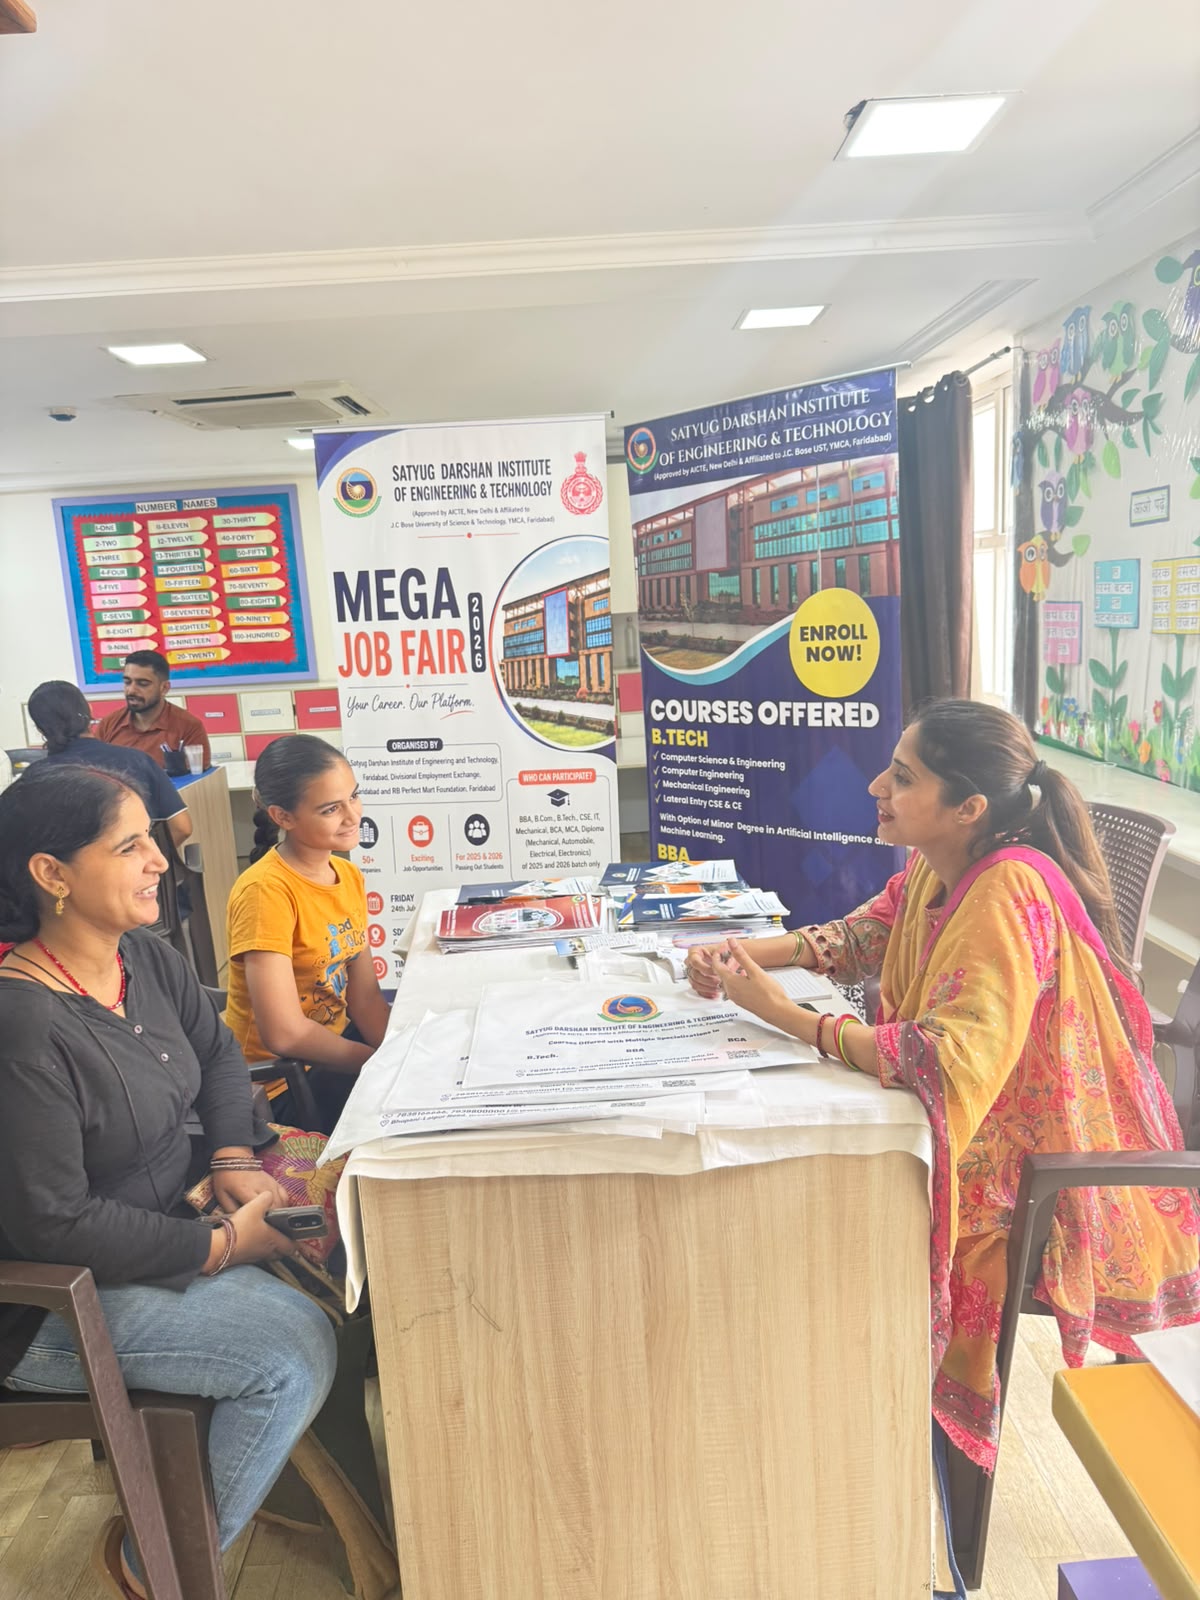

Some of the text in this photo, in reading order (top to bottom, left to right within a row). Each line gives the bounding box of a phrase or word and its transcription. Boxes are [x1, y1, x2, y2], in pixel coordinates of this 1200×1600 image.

[671, 389, 870, 442] SATYUG DARSHAN INSTITUTE
[659, 410, 892, 466] OF ENGINEERING & TECHNOLOGY
[654, 432, 891, 480] (Approved AICTE, New Delhi Affiliated Bose UST, YMCA, Faridabad)
[392, 459, 551, 481] SATYUG DARSHAN INSTITUTE
[394, 481, 552, 501] OF ENGINEERING & TECHNOLOGY
[137, 499, 216, 512] NUMBER NAMES
[222, 516, 256, 525] 30-THIRTY
[527, 516, 554, 524] Faridabad)
[158, 535, 194, 545] 12-TWELVE
[238, 549, 266, 557] 50-FIFTY
[91, 554, 120, 562] 3-THREE
[158, 564, 203, 573] 14-FOURTEEN
[229, 566, 258, 574] 60-SIXTY
[165, 579, 201, 587] 15-FIFTEEN
[228, 582, 268, 590] 70-SEVENTY
[172, 593, 208, 601] 16-SIXTEEN
[333, 567, 460, 622] MEGA
[240, 597, 275, 605] 80-EIGHTY
[164, 608, 210, 617] 17-SEVENTEEN
[235, 615, 271, 623] 90-NINETY
[235, 631, 280, 639] 100-HUNDRED
[472, 597, 482, 668] 2026
[800, 624, 867, 642] ENROLL
[177, 651, 216, 660] 20-TWENTY
[338, 629, 467, 678] JOB FAIR
[806, 645, 862, 662] NOW!
[347, 693, 474, 717] Your Career. Our Platform.
[651, 699, 879, 728] COURSES OFFERED
[652, 728, 708, 747] B.TECH
[392, 741, 438, 750] ORGANISED BY
[351, 760, 367, 768] Satyug
[391, 758, 414, 766] Institute
[422, 757, 454, 766] Engineering
[661, 753, 785, 771] Computer Science & Engineering
[419, 772, 452, 781] Employment
[523, 772, 592, 782] WHO CAN PARTICIPATE?
[662, 766, 744, 782] Computer Engineering
[402, 786, 421, 794] Perfect
[662, 780, 750, 797] Mechanical Engineering
[663, 794, 742, 810] Lateral Entry CSE CE
[519, 815, 533, 823] BBA,
[582, 825, 604, 833] Diploma
[660, 812, 872, 845] With Option of Minor Degree in Artificial Intelligence
[660, 825, 725, 843] Machine Learning.
[525, 839, 560, 847] (Mechanical,
[488, 852, 502, 860] 2026
[559, 849, 591, 857] Electronics)
[658, 843, 689, 862] BBA
[362, 856, 374, 864] 50+
[411, 854, 434, 863] Exciting
[526, 1026, 553, 1035] SATYUG
[638, 1020, 685, 1029] ENGINEERING
[693, 1013, 739, 1023] TECHNOLOGY
[579, 1038, 606, 1046] Offered
